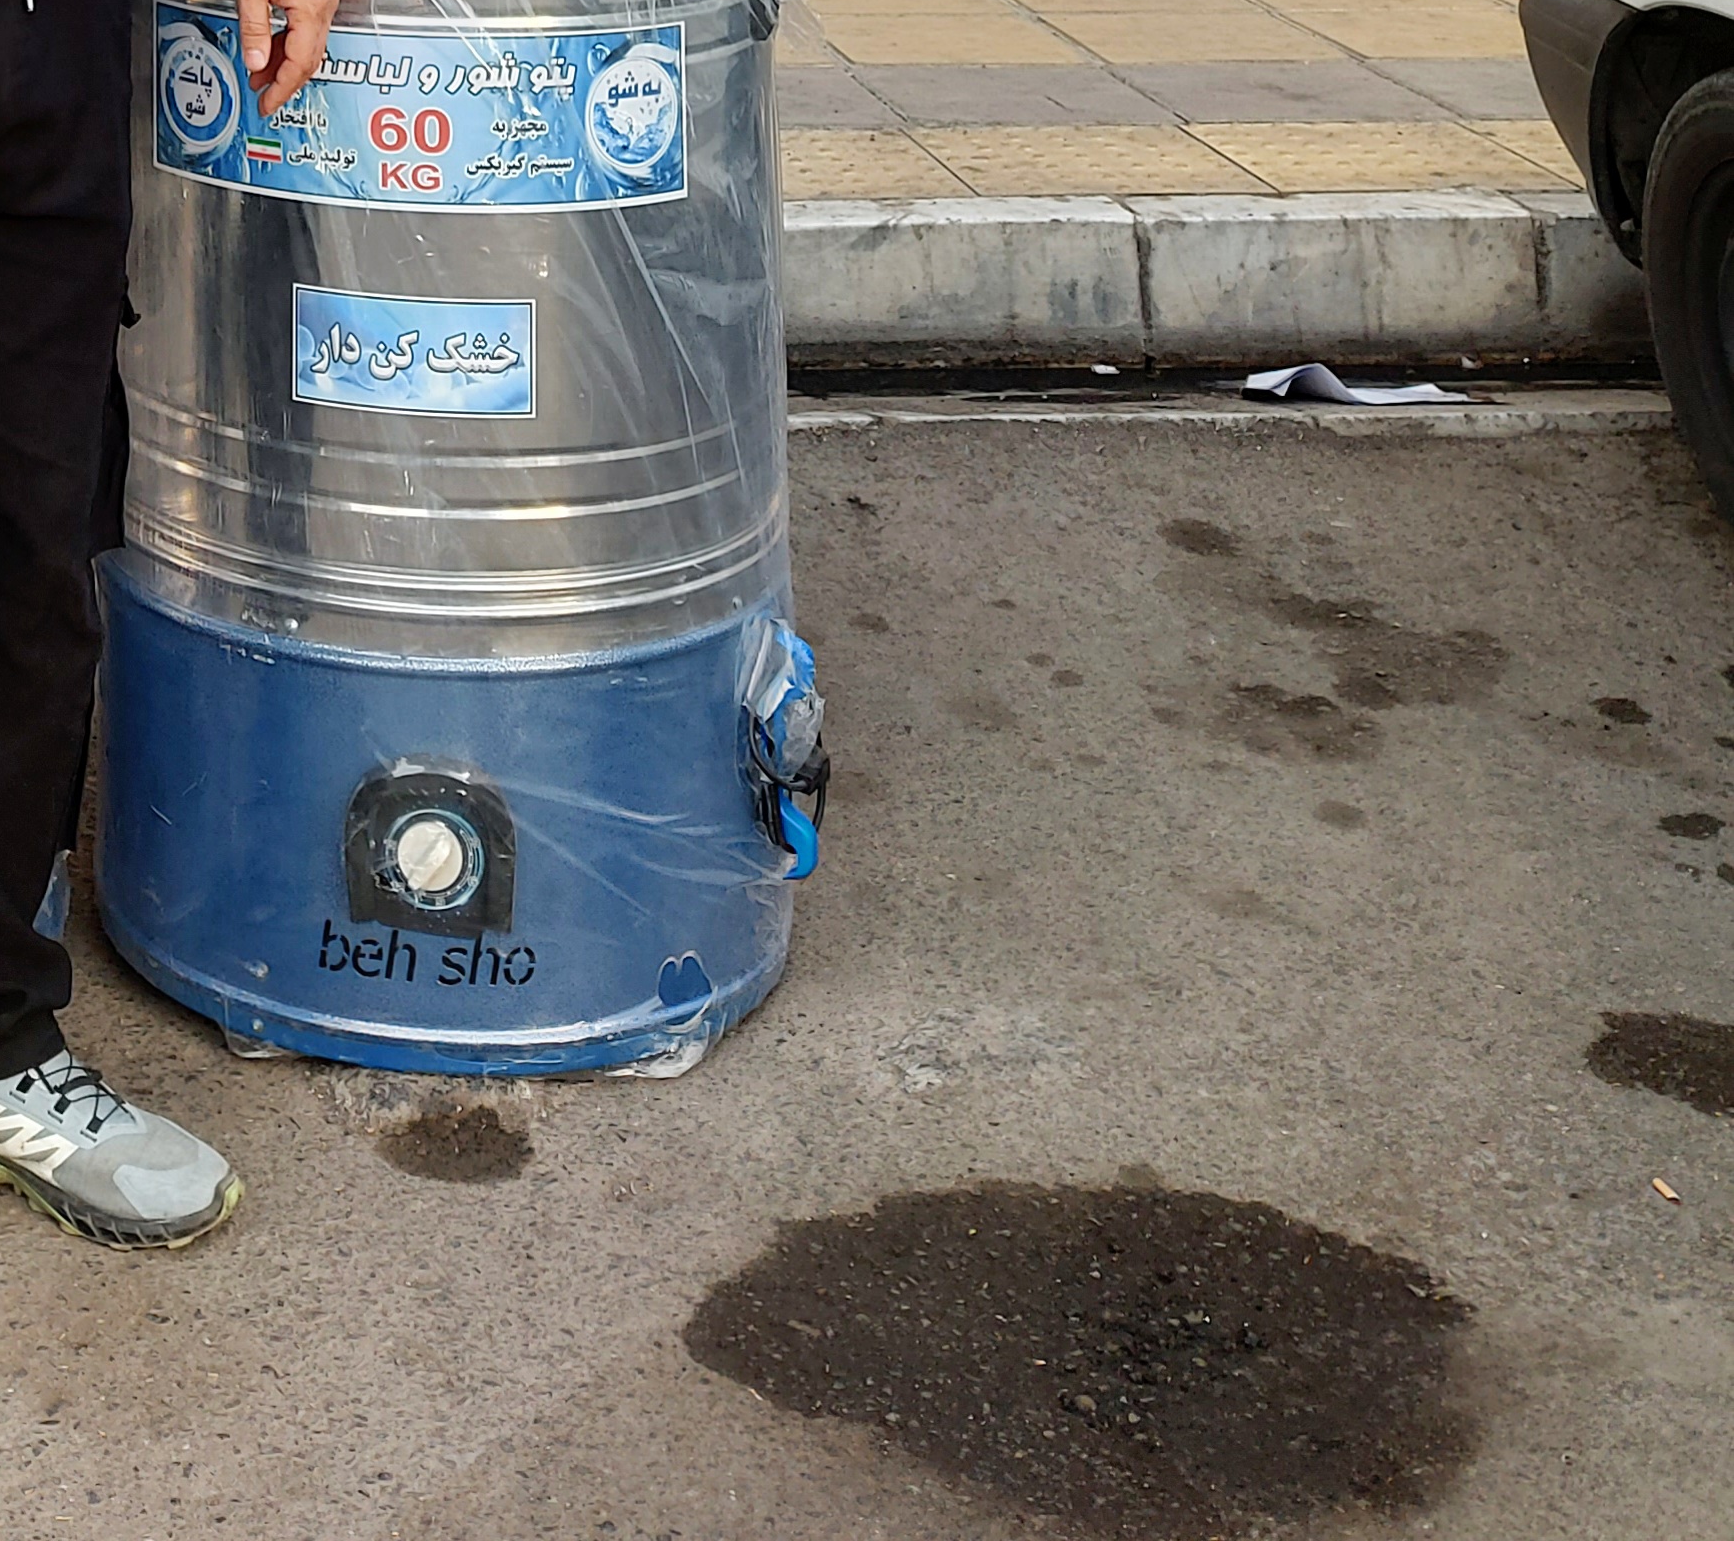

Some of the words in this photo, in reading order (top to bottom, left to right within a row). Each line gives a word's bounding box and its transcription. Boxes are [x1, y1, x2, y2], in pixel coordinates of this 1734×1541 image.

[417, 60, 440, 95] و
[447, 50, 524, 95] شور
[529, 57, 578, 97] پتو
[369, 105, 452, 155] 60
[379, 162, 444, 192] KG
[311, 323, 362, 375] دار
[368, 331, 419, 381] کن
[427, 330, 519, 376] خشک
[318, 918, 416, 984] beh
[437, 927, 536, 987] sho
